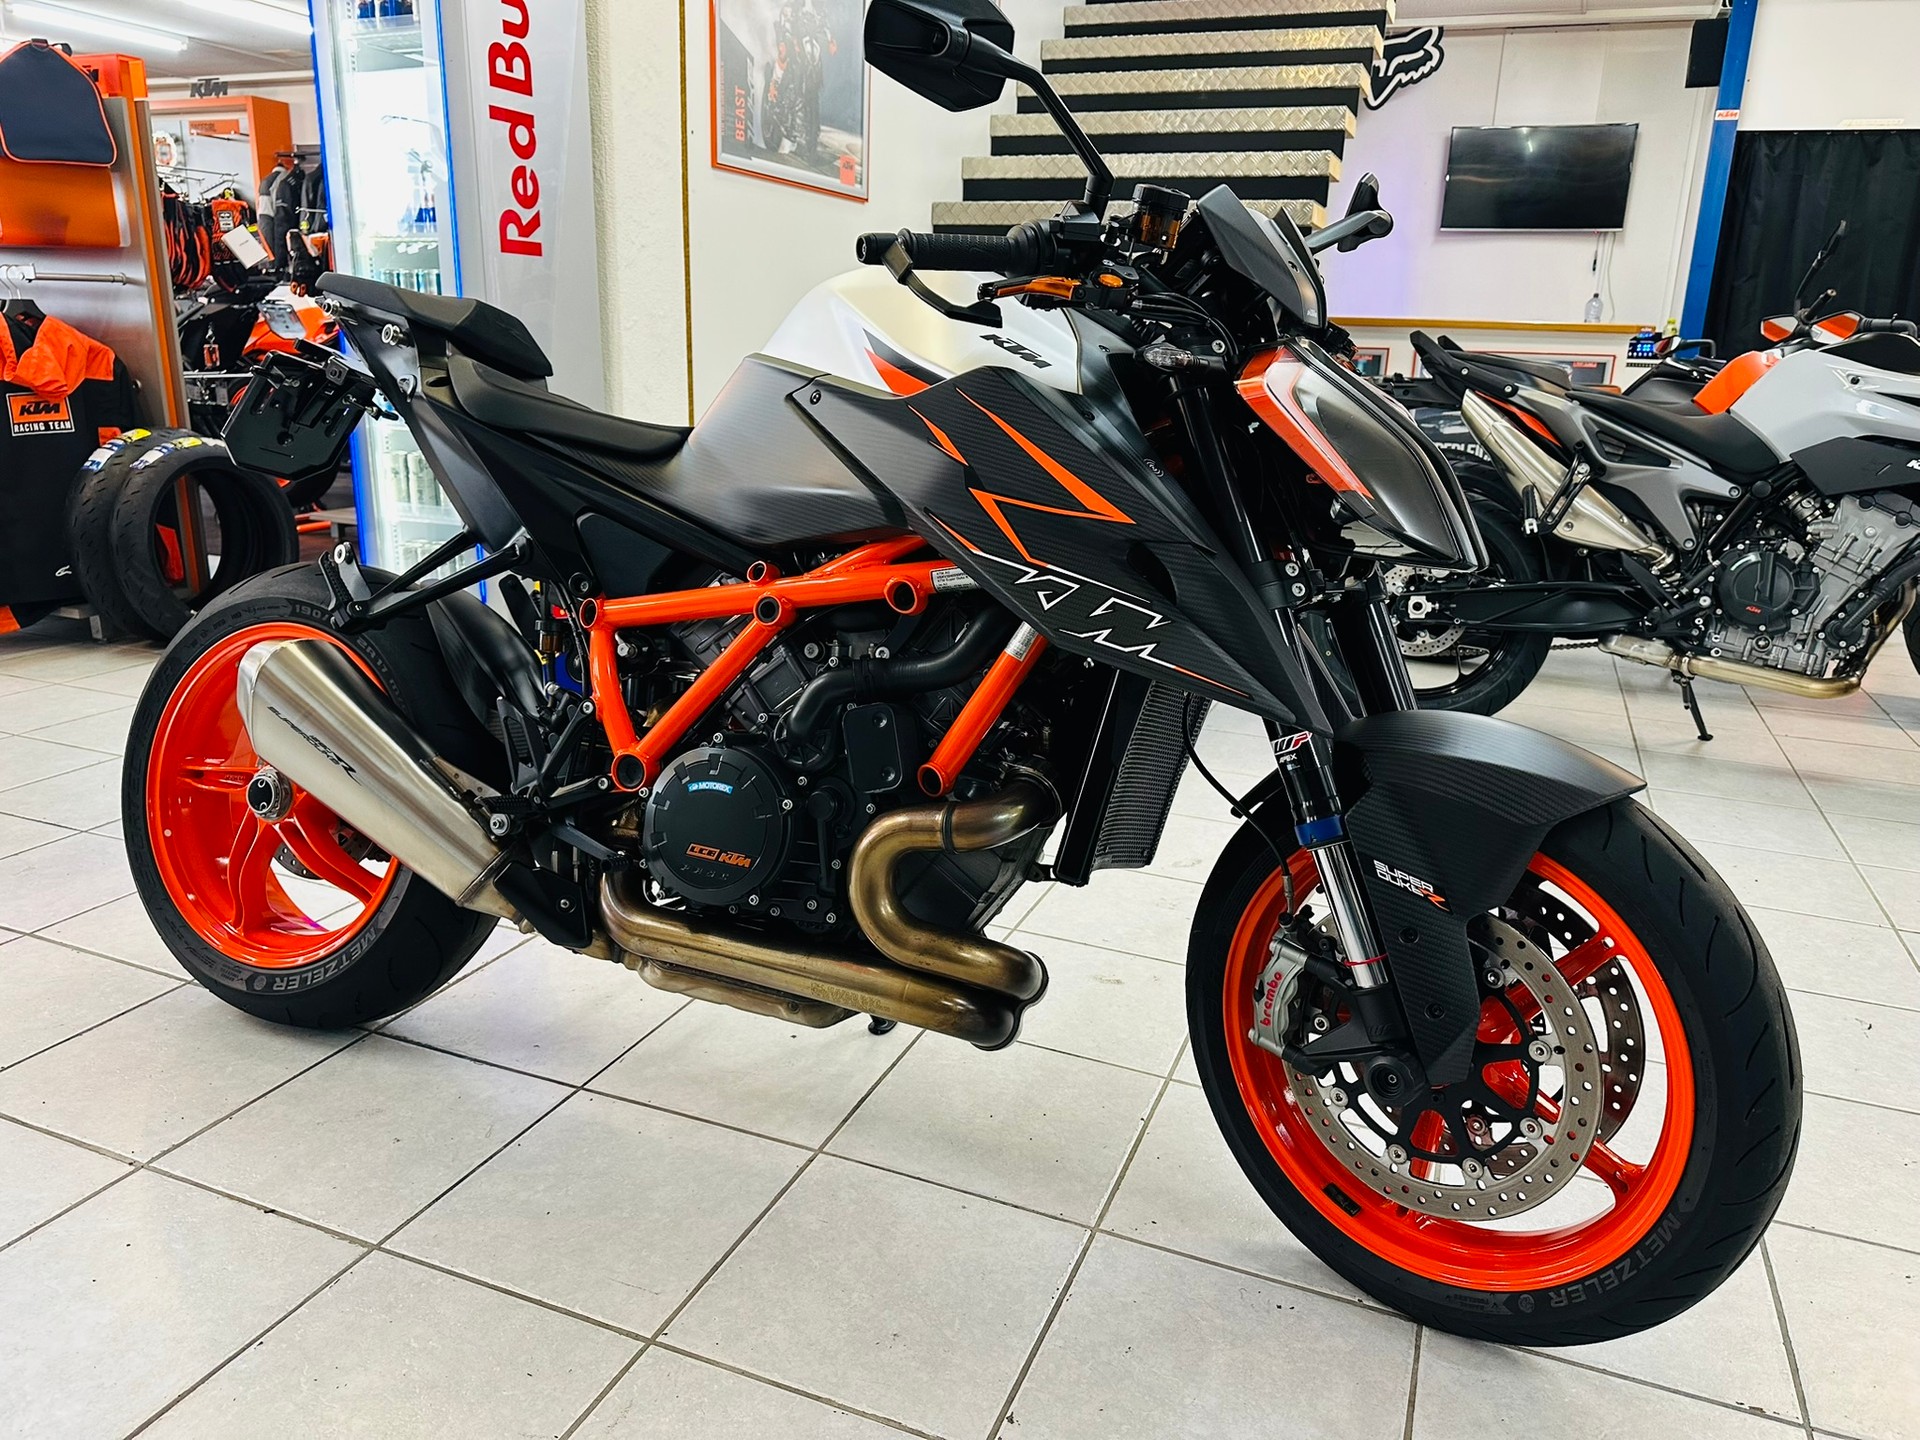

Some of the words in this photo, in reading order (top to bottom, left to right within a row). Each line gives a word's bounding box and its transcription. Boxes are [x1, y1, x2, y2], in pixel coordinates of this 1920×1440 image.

[190, 78, 229, 98] KTM
[735, 85, 746, 142] BEAST
[488, 104, 543, 257] Red
[979, 334, 1053, 369] KTM
[19, 401, 61, 416] KTM
[14, 421, 45, 433] RACING
[49, 420, 71, 430] TEAM
[294, 603, 331, 621] 190/
[699, 782, 732, 795] MOTOREX
[719, 851, 752, 868] KTM
[1373, 859, 1434, 894] SUPER
[1376, 868, 1425, 898] DUKE
[272, 926, 377, 991] METZELER
[1260, 971, 1283, 1027] brembo
[1548, 1212, 1682, 1308] METZELER
